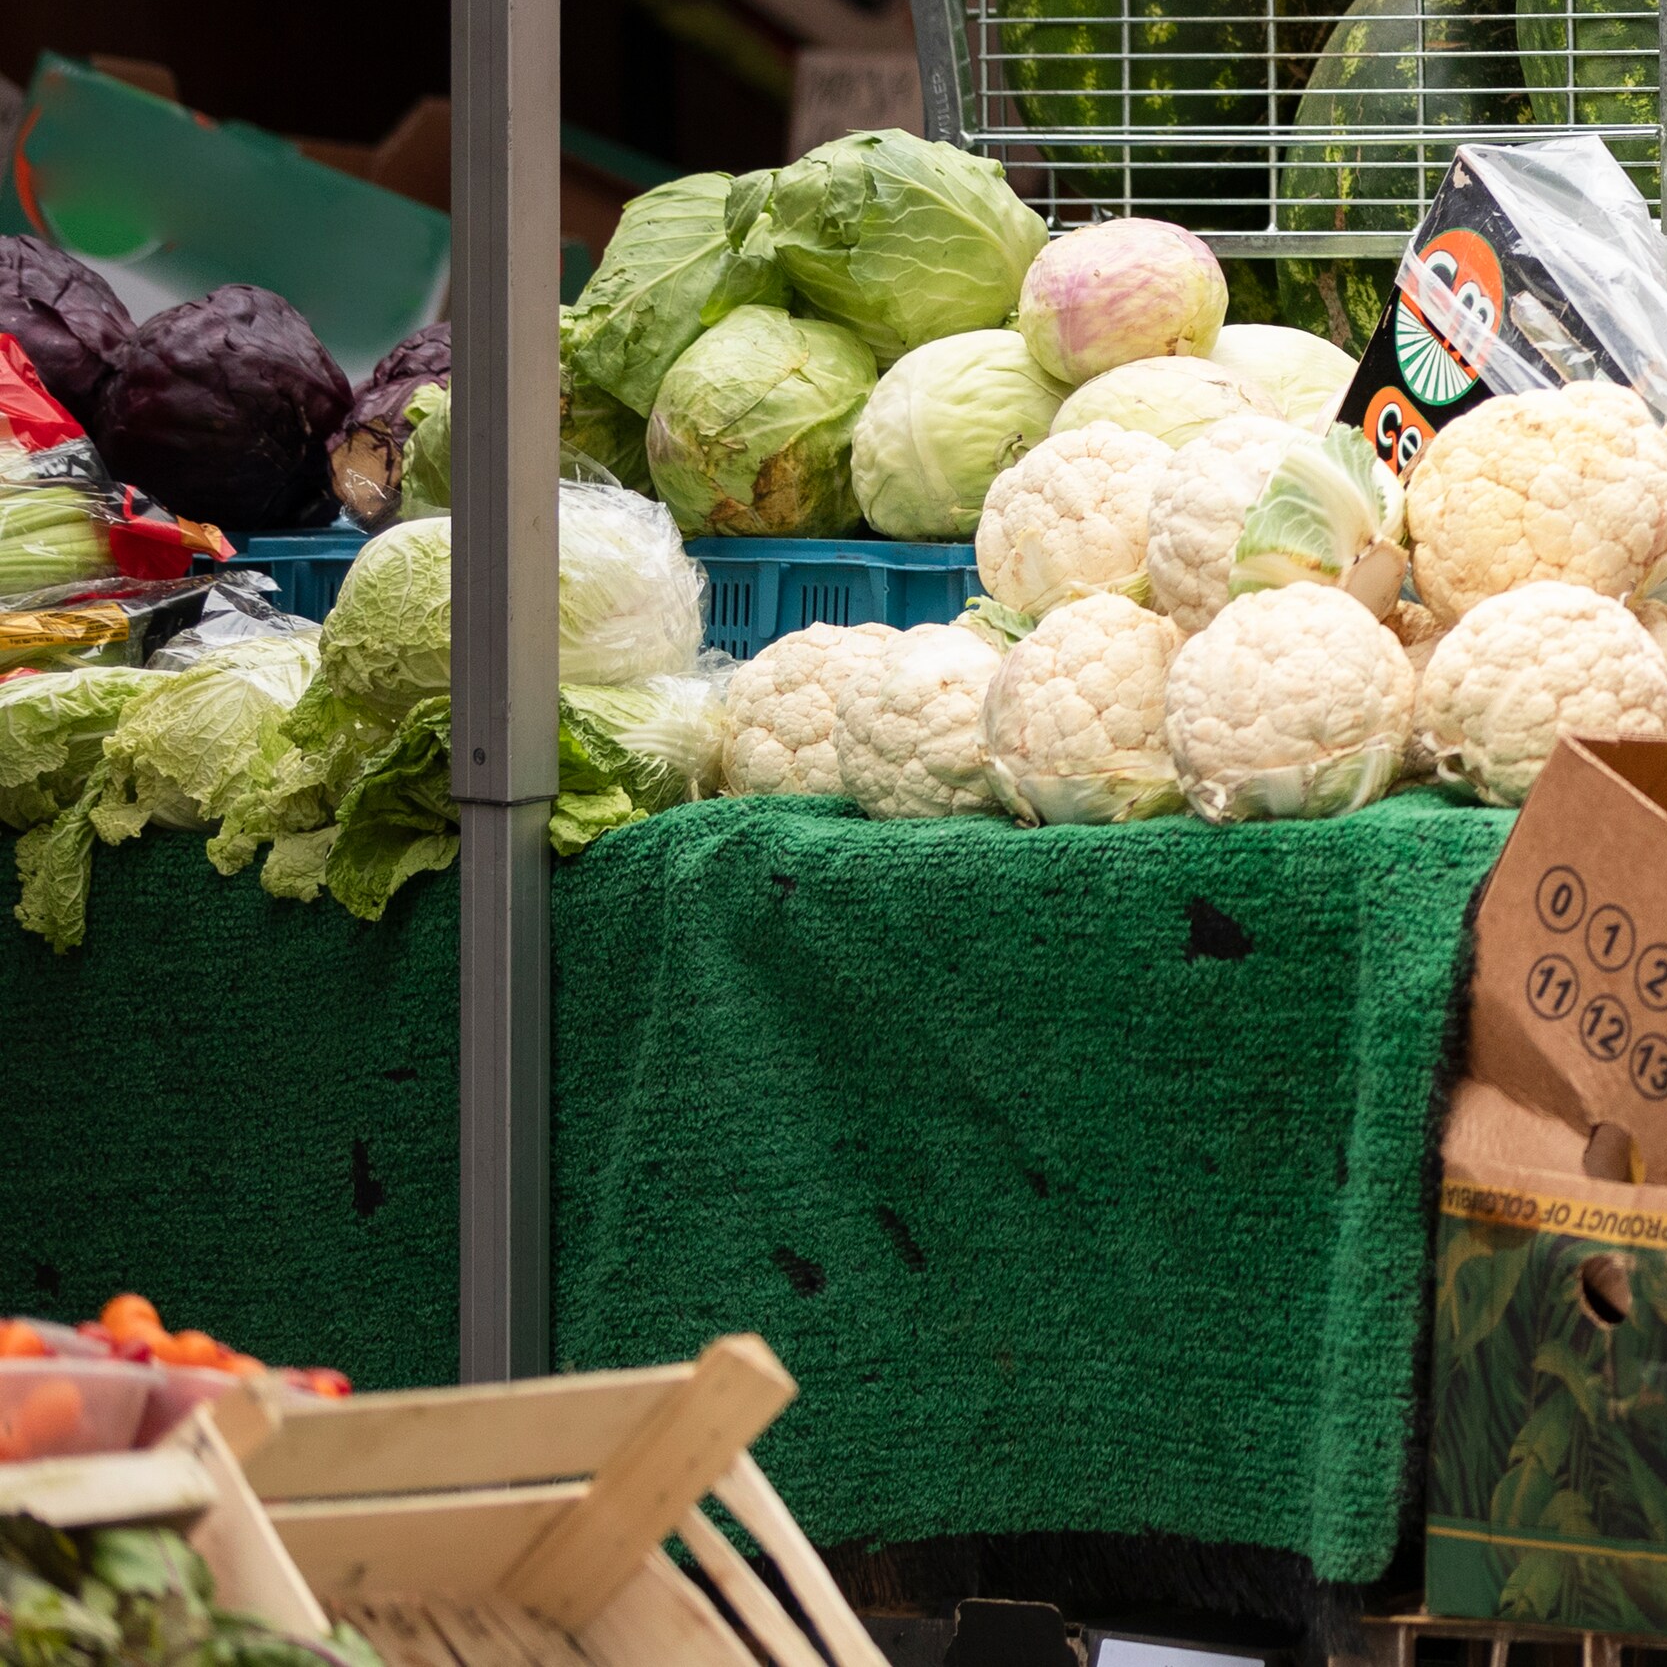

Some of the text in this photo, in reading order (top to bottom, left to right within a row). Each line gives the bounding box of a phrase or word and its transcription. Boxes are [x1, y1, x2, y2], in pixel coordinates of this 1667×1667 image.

[1536, 965, 1573, 1012] 11
[1586, 1004, 1625, 1056] 12
[1543, 1200, 1571, 1227] OF
